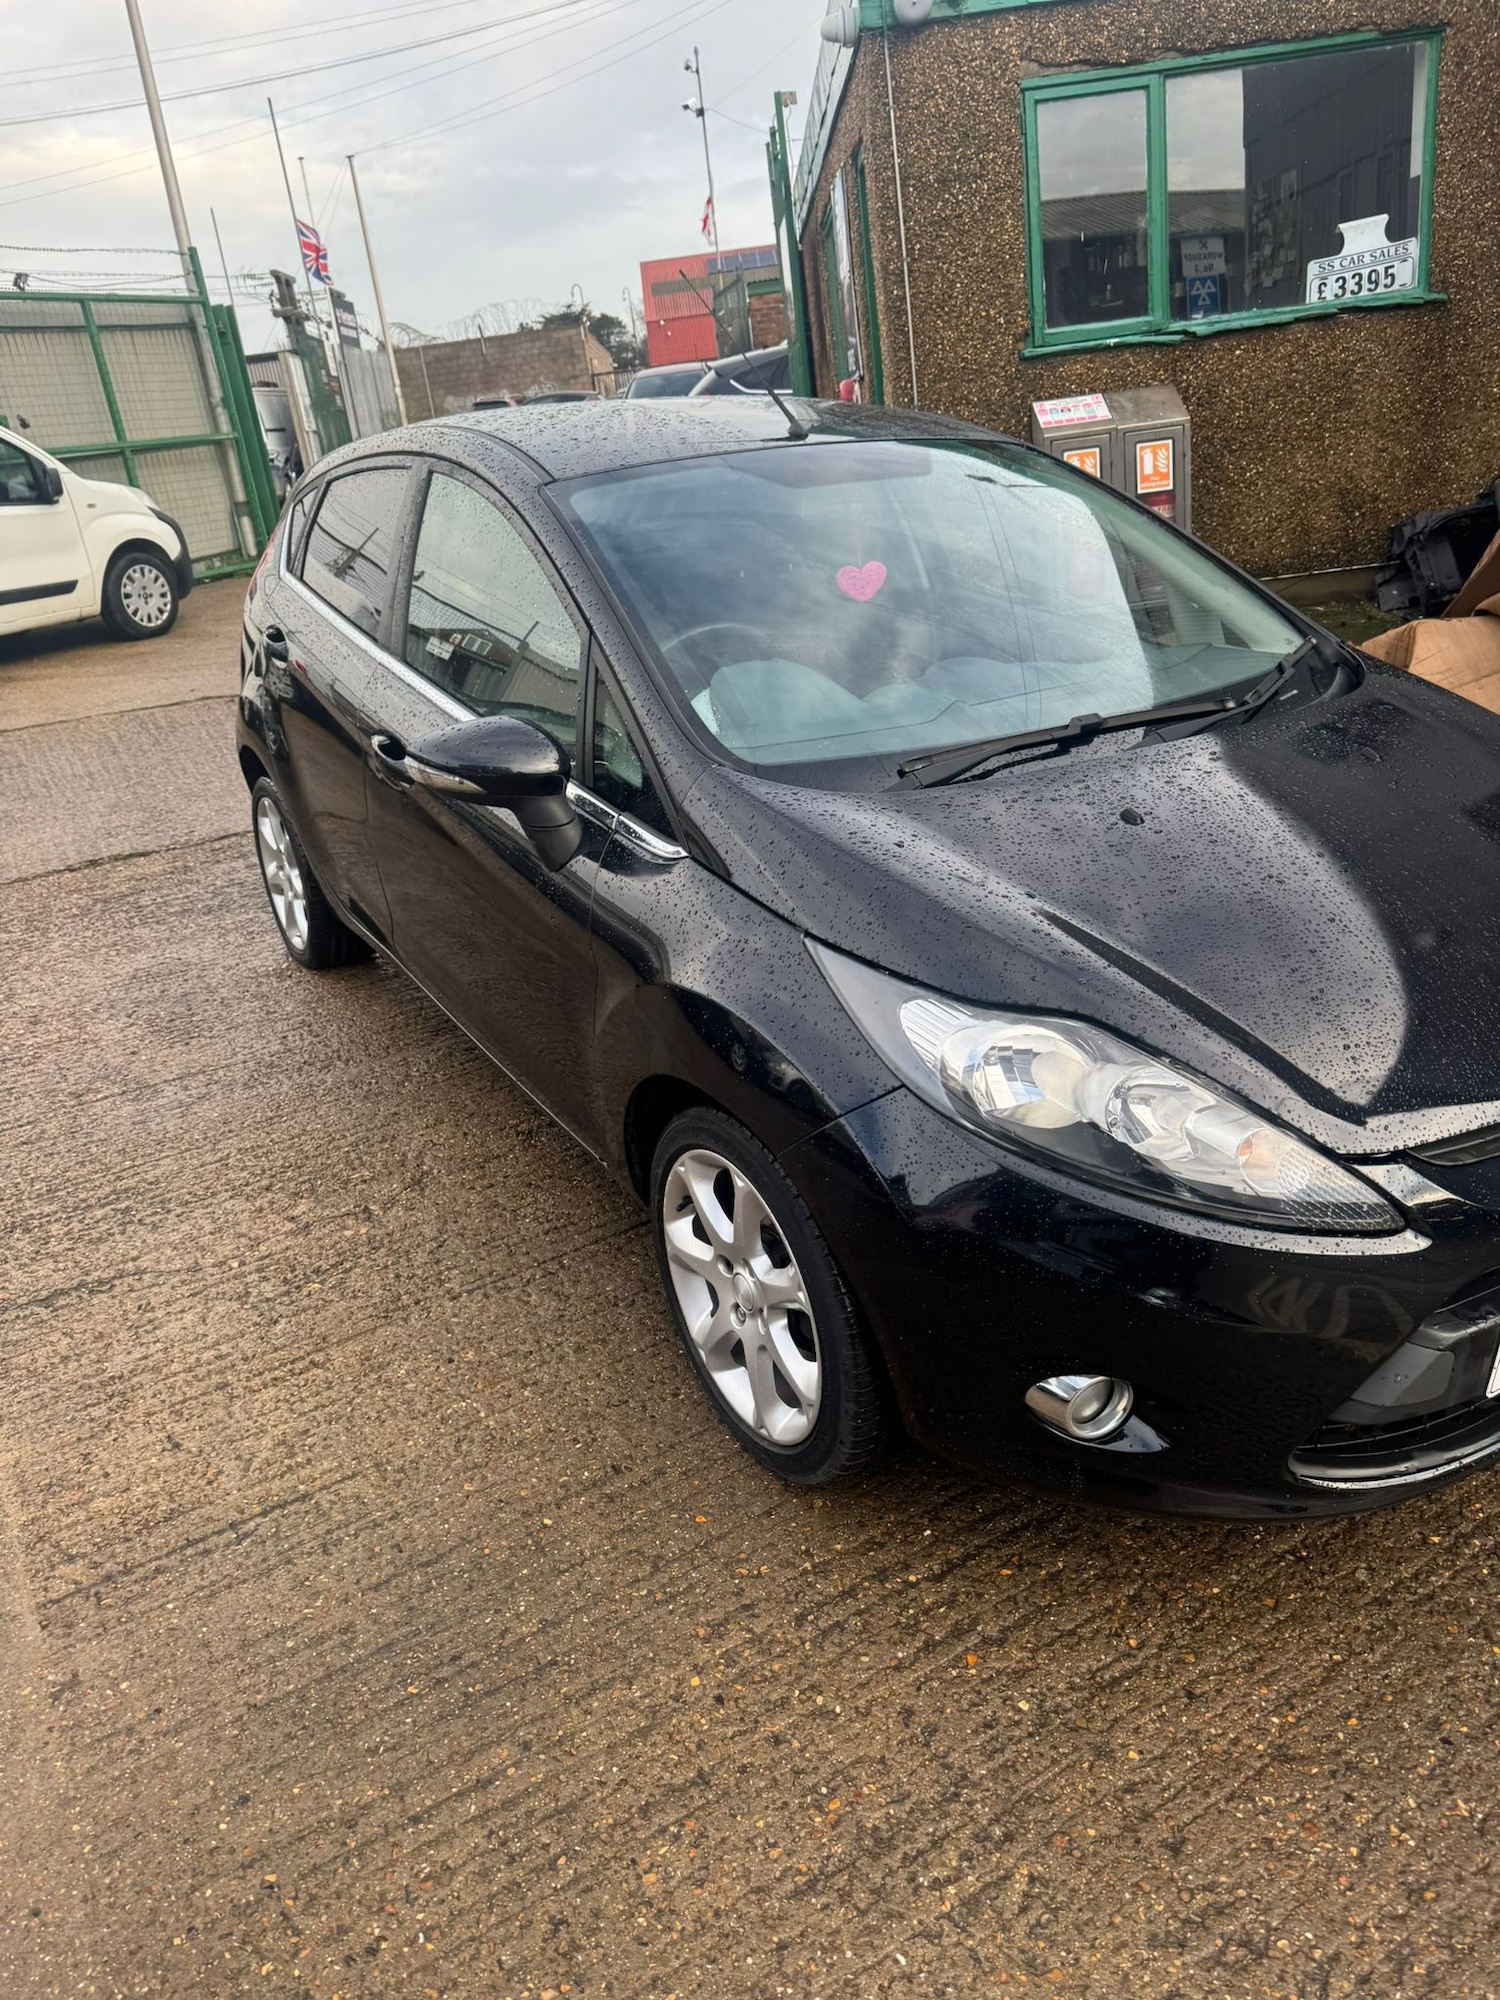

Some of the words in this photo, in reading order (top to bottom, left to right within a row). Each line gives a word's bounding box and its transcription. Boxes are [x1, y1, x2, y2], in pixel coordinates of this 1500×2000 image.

[1318, 261, 1335, 273] SS
[1339, 254, 1365, 268] CAR
[1370, 244, 1409, 262] SALES
